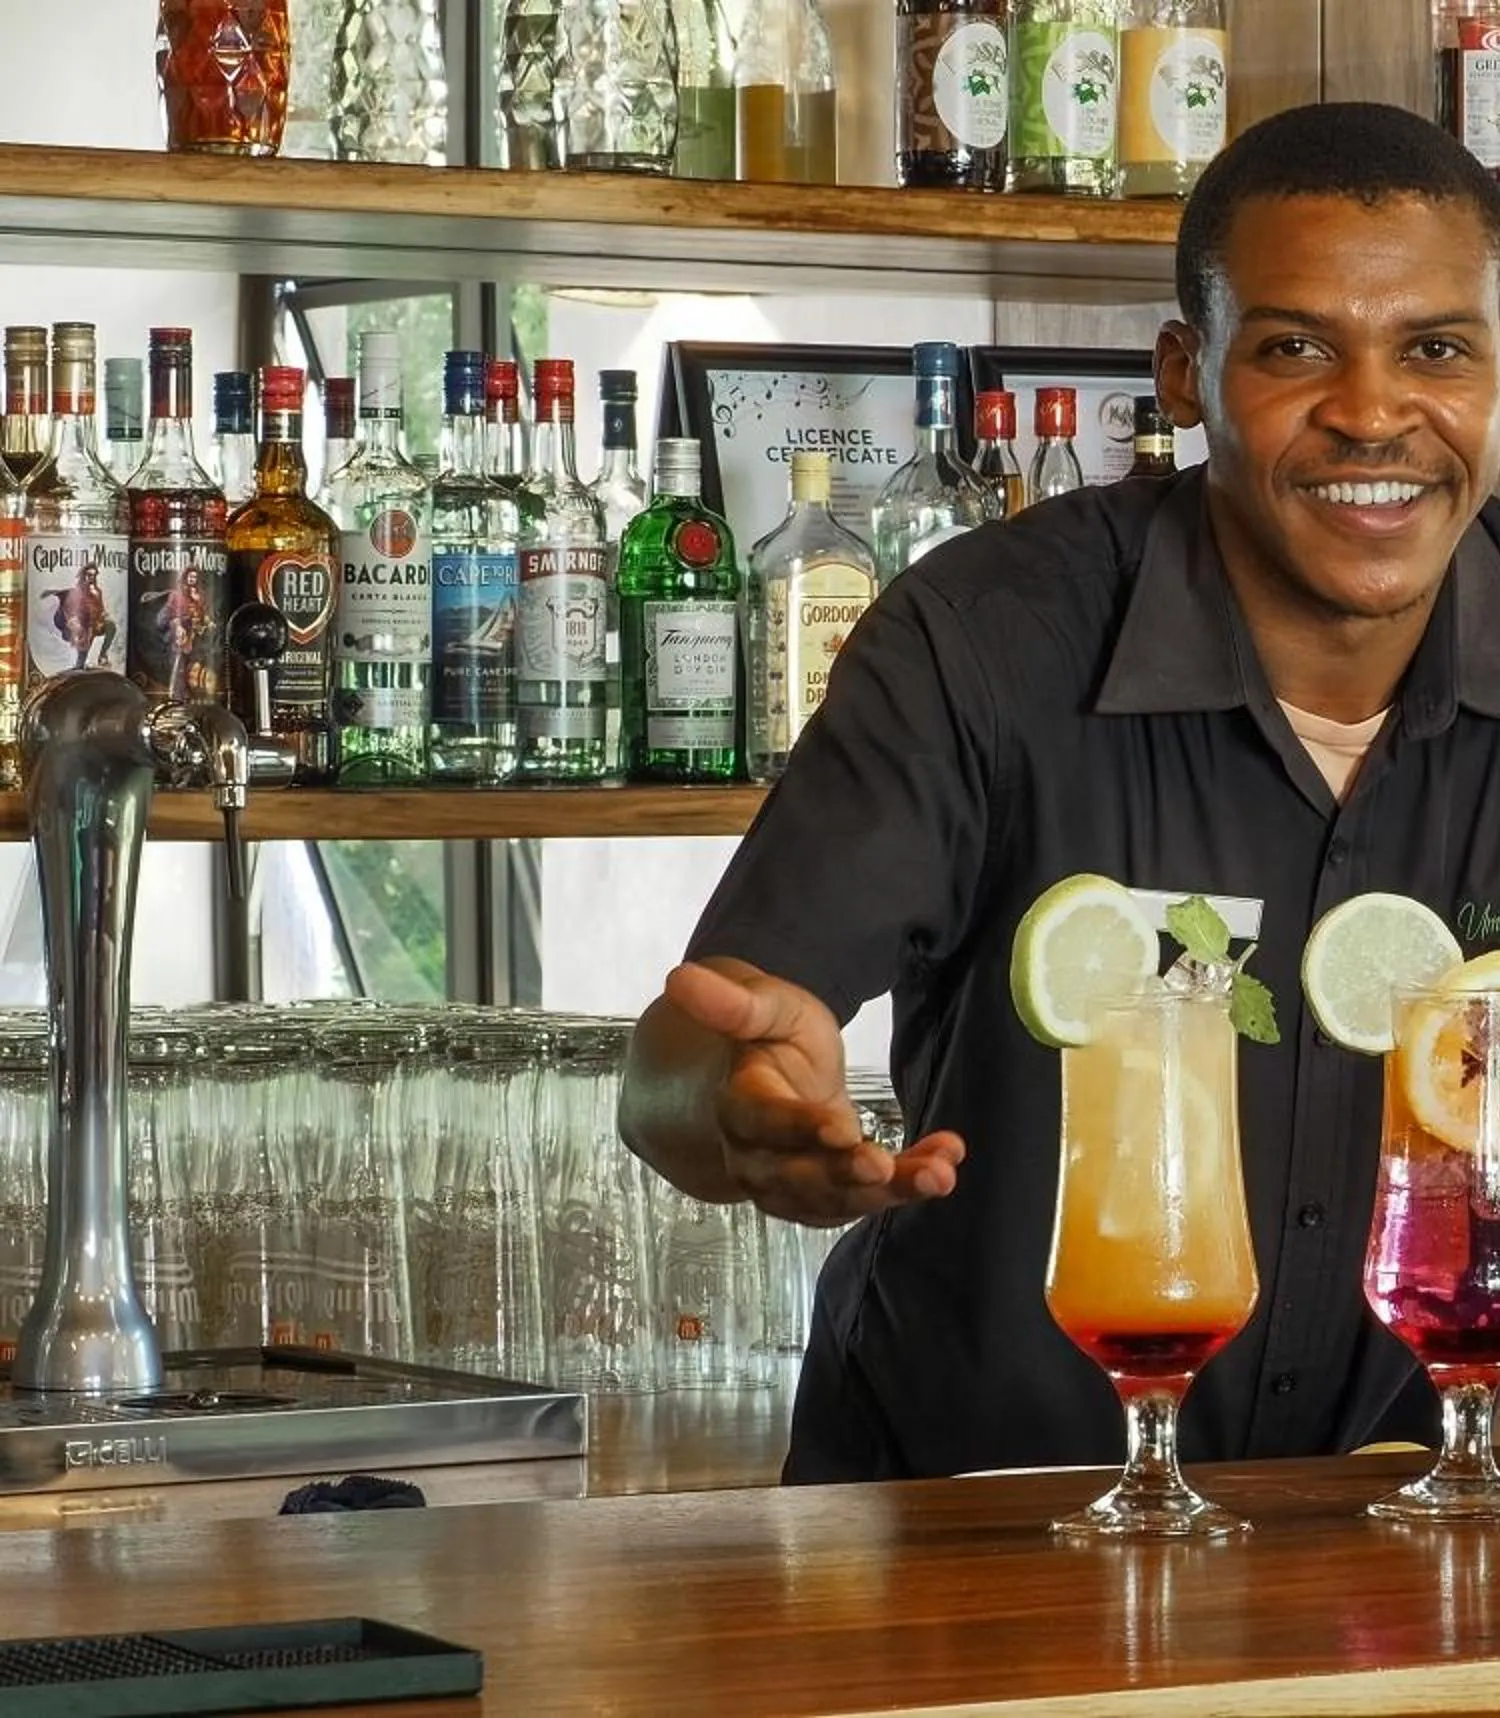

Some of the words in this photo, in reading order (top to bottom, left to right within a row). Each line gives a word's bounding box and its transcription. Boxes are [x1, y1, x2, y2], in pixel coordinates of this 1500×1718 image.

[786, 428, 873, 445] LICENCE
[766, 446, 898, 464] CEFICATE
[33, 544, 88, 573] Captain
[134, 548, 188, 576] Captain
[284, 571, 324, 596] RED
[439, 565, 490, 587] CAPE
[283, 598, 323, 613] HEART
